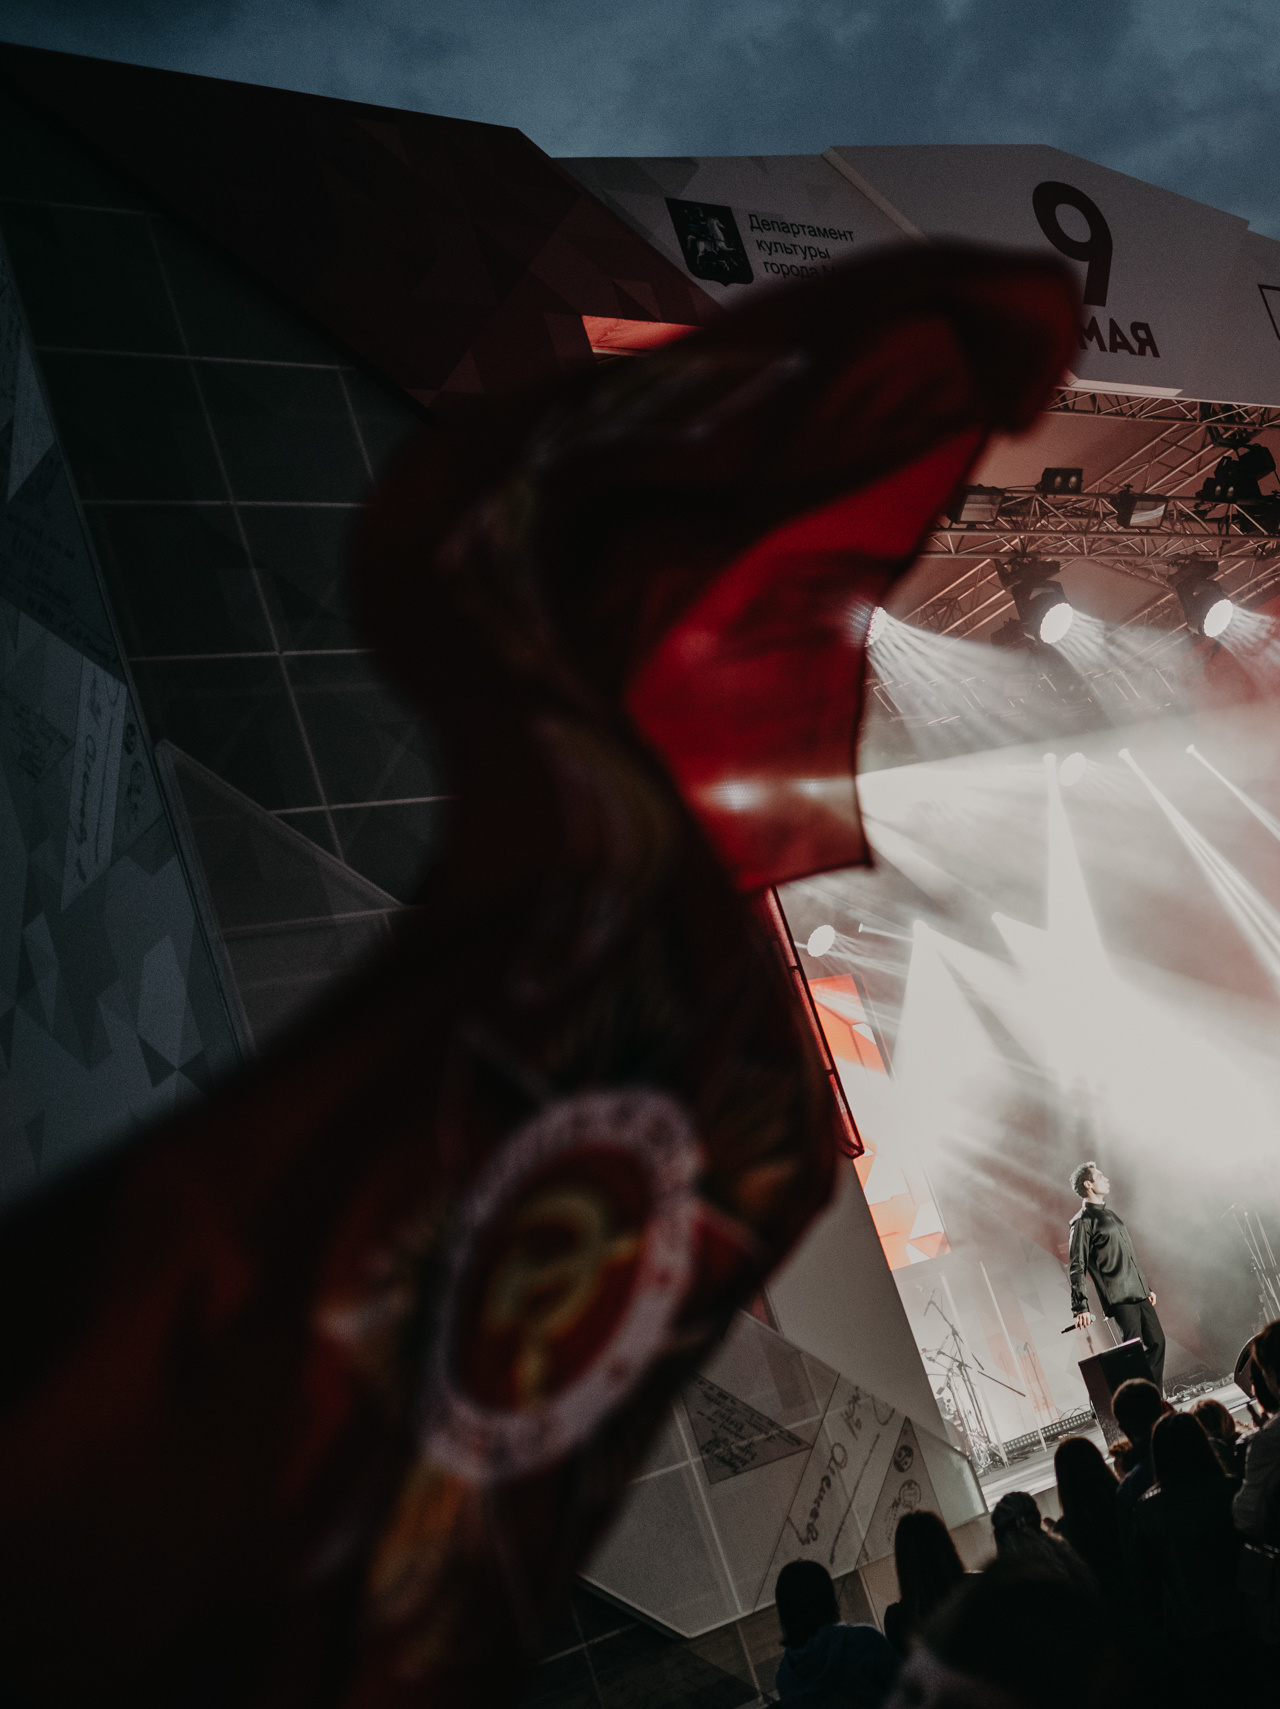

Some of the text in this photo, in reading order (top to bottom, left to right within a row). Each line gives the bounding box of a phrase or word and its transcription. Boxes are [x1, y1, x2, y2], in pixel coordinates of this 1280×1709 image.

[748, 213, 855, 242] Департамент
[755, 239, 831, 260] культуры
[1032, 180, 1113, 307] 9
[763, 261, 819, 280] города
[1077, 315, 1161, 358] МАЯ
